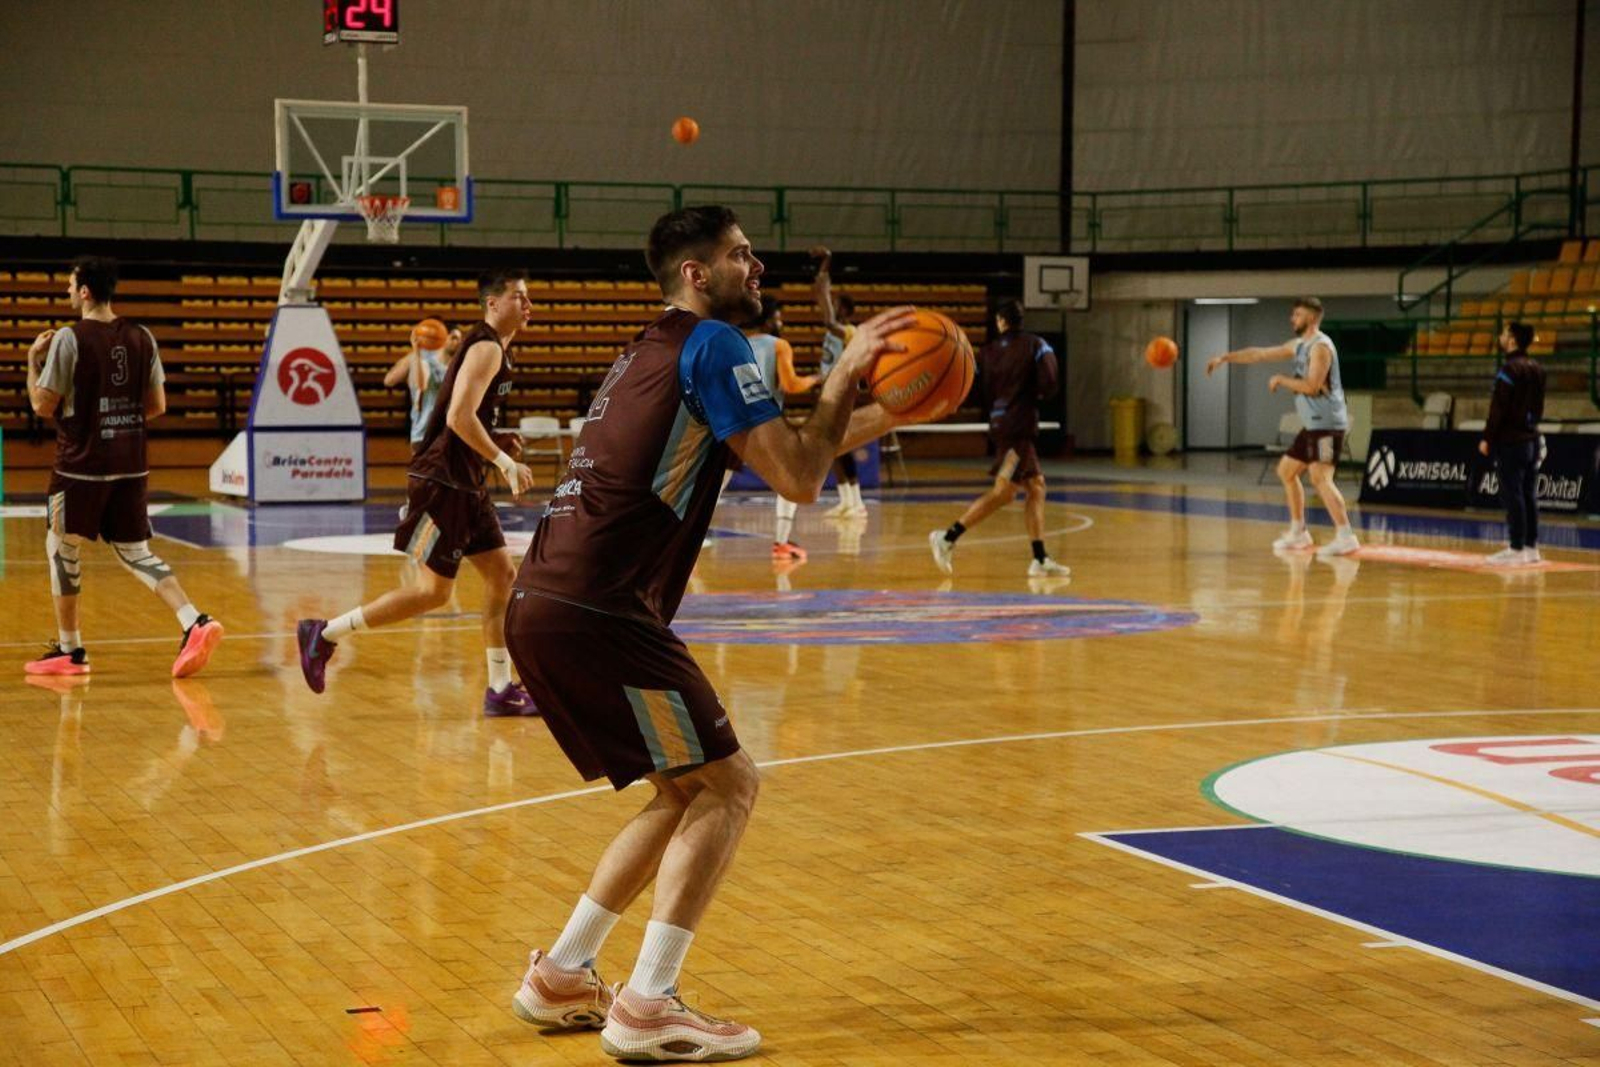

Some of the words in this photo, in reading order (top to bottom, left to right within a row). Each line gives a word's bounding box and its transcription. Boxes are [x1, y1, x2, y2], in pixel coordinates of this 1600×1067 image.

[346, 0, 391, 28] 24
[111, 346, 128, 386] 3
[1398, 460, 1468, 481] XURISGAL
[1536, 473, 1583, 500] Dixital
